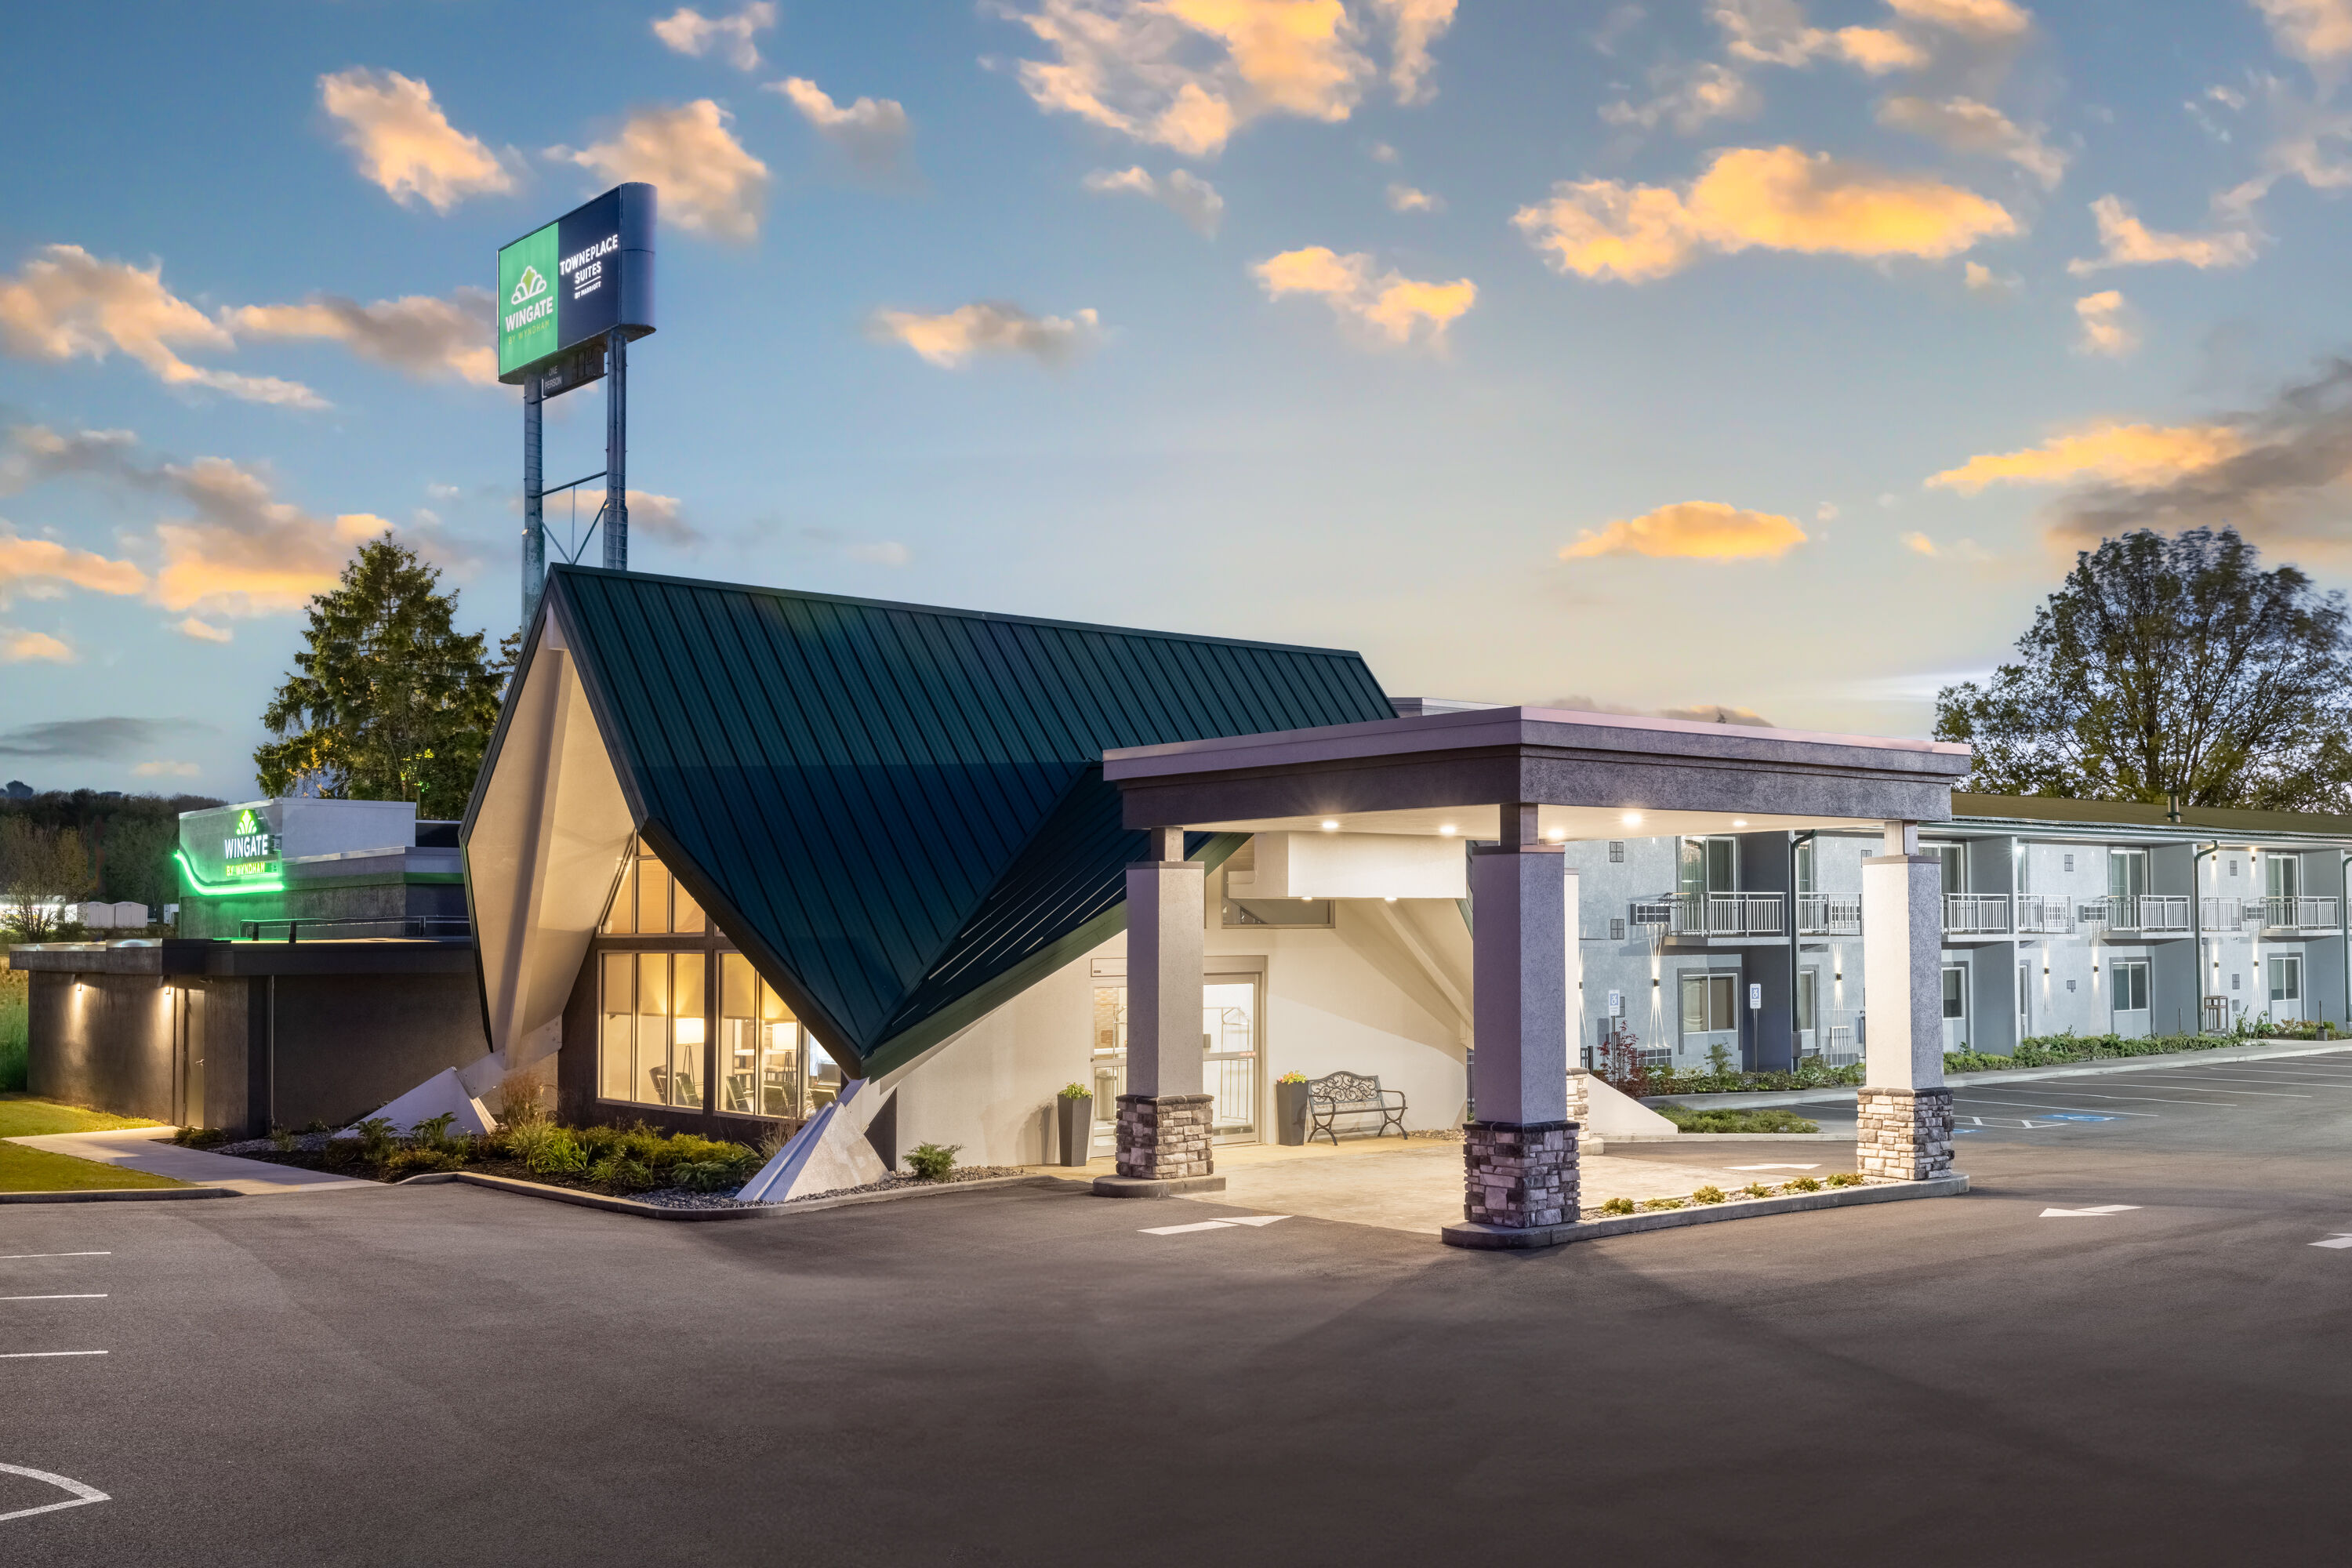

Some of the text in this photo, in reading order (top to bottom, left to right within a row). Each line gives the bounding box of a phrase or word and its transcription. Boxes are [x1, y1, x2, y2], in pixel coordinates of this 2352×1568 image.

[559, 234, 618, 275] TOWNEPLACE
[574, 261, 601, 284] SUITES
[581, 281, 601, 296] MARRIOTT
[506, 296, 554, 332] WINGATE
[508, 319, 550, 346] BY WYNDHAM
[224, 833, 268, 859] WINGATE
[227, 862, 265, 876] BY WYNDHAM
